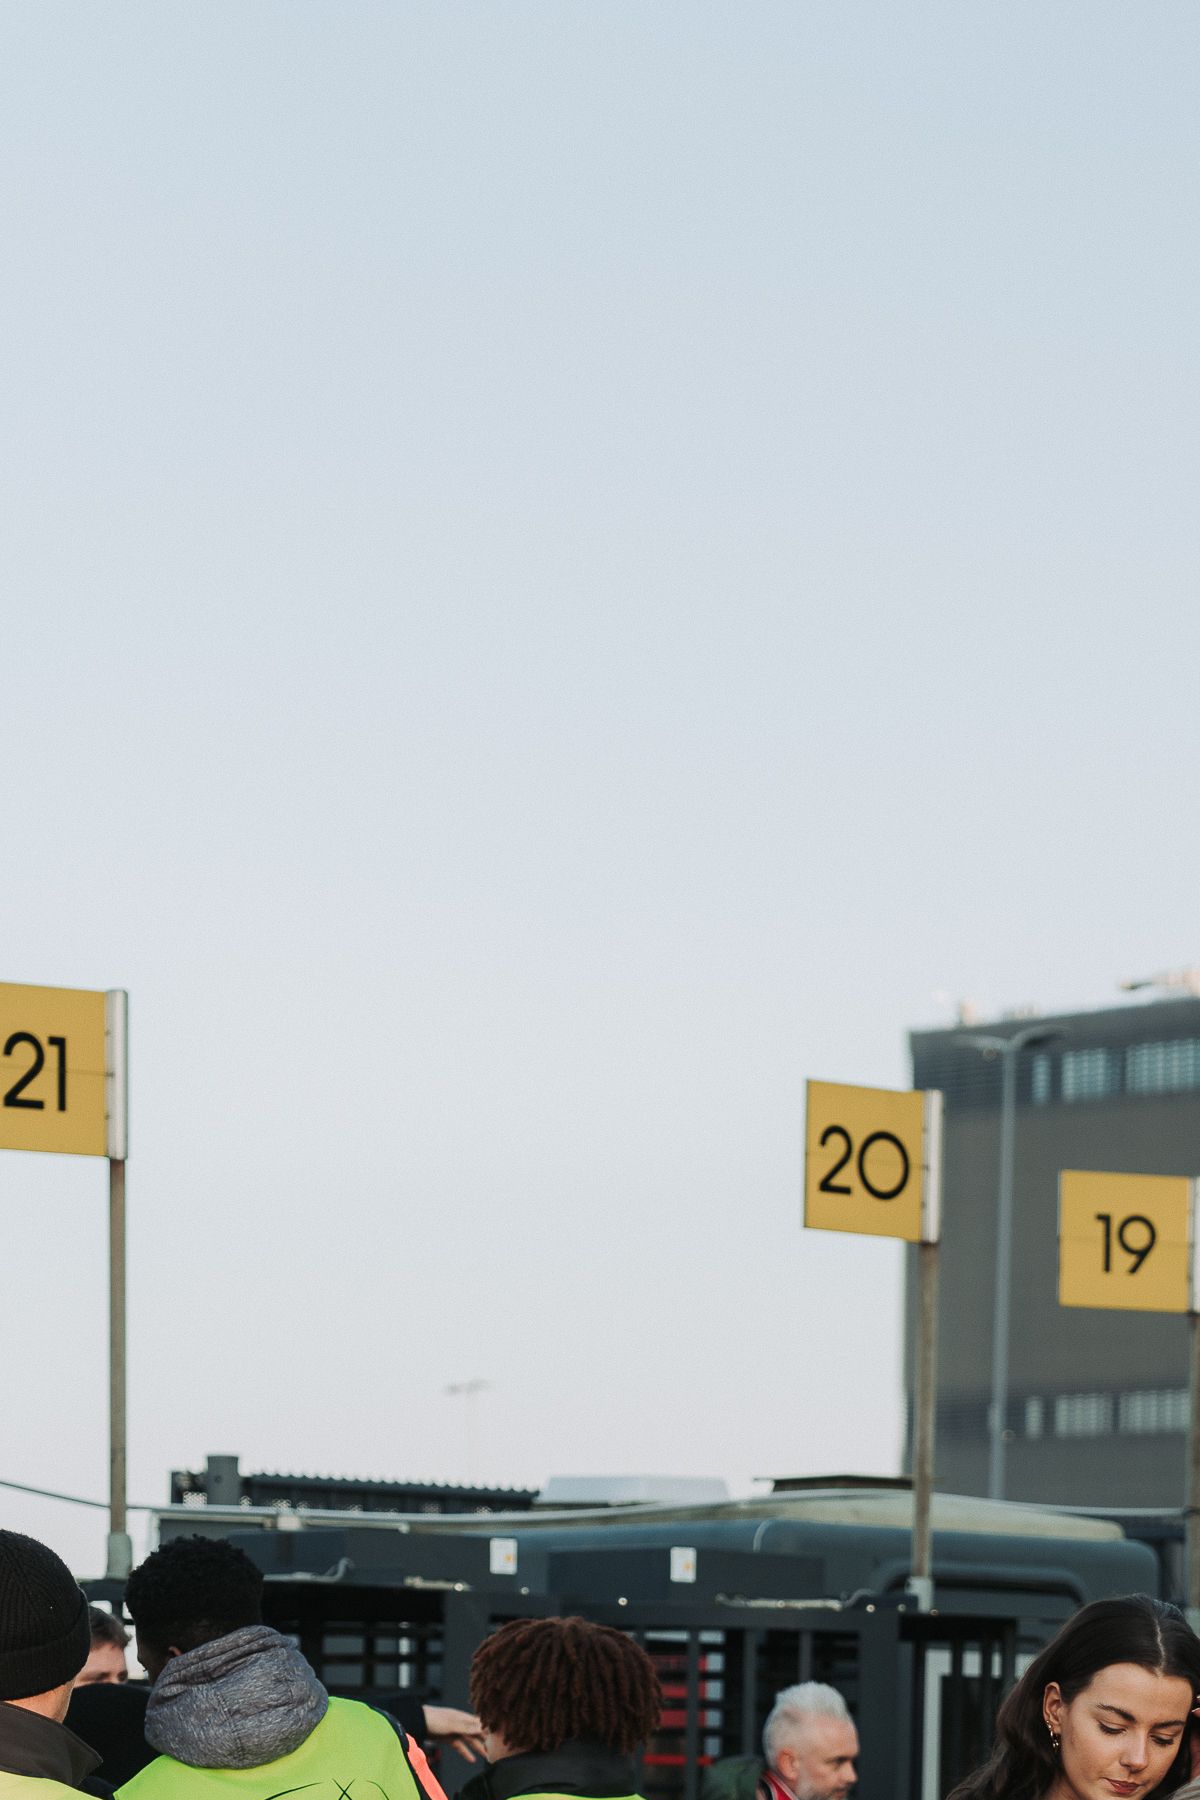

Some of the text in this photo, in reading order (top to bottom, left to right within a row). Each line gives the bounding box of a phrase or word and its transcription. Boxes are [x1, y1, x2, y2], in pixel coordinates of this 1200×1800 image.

[4, 1031, 66, 1112] 21
[819, 1125, 910, 1200] 20
[1095, 1212, 1157, 1274] 19
